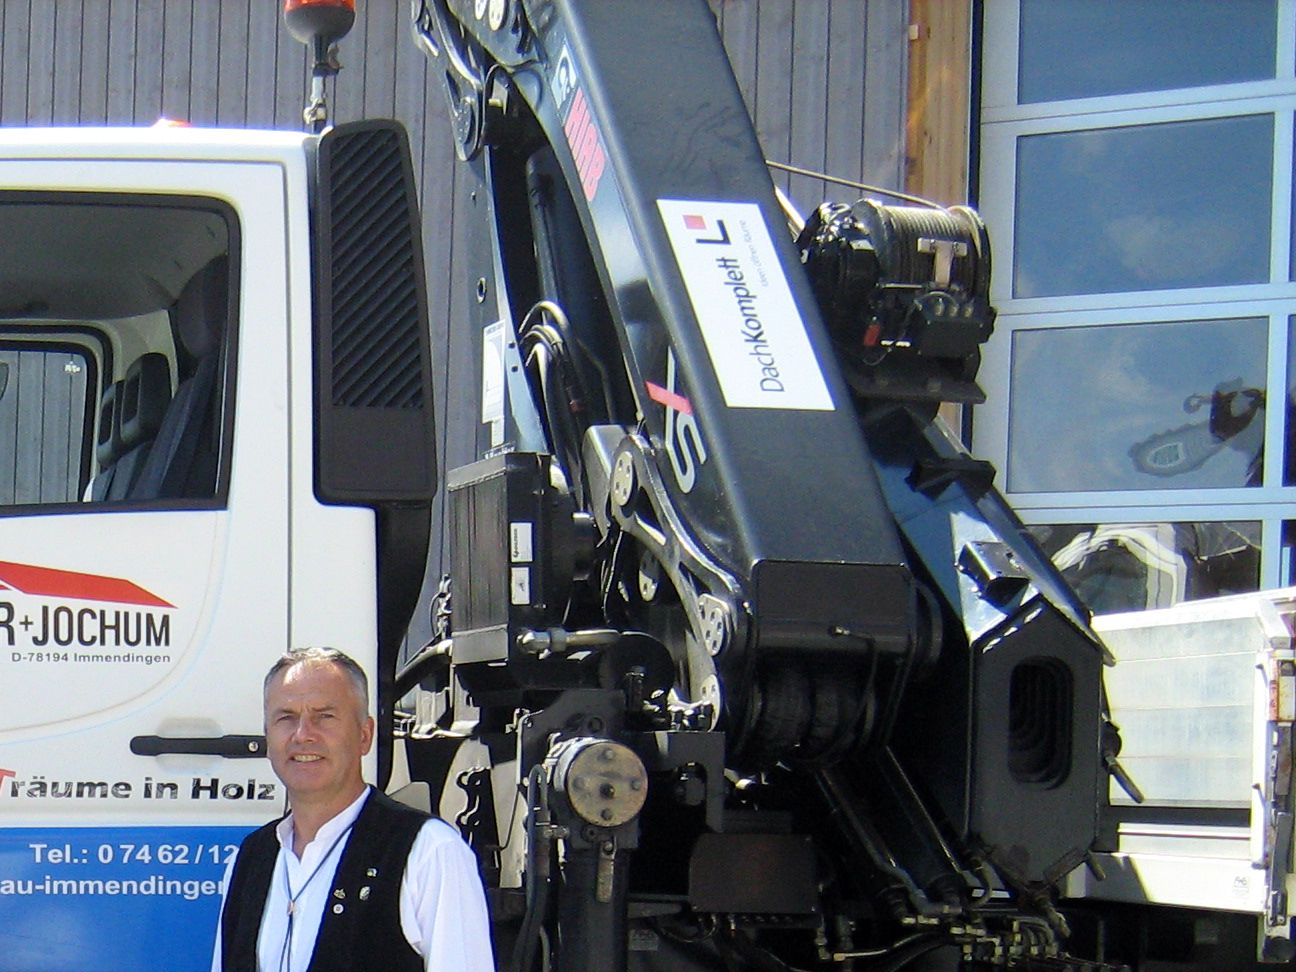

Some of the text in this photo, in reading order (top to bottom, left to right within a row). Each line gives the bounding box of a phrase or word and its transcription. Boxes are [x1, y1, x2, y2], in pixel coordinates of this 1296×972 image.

[716, 257, 785, 393] DachKomplett
[11, 652, 69, 663] D-78194
[74, 652, 171, 664] Immendingen
[143, 777, 178, 799] in
[191, 778, 275, 801] Holz
[29, 844, 88, 865] Tel.:
